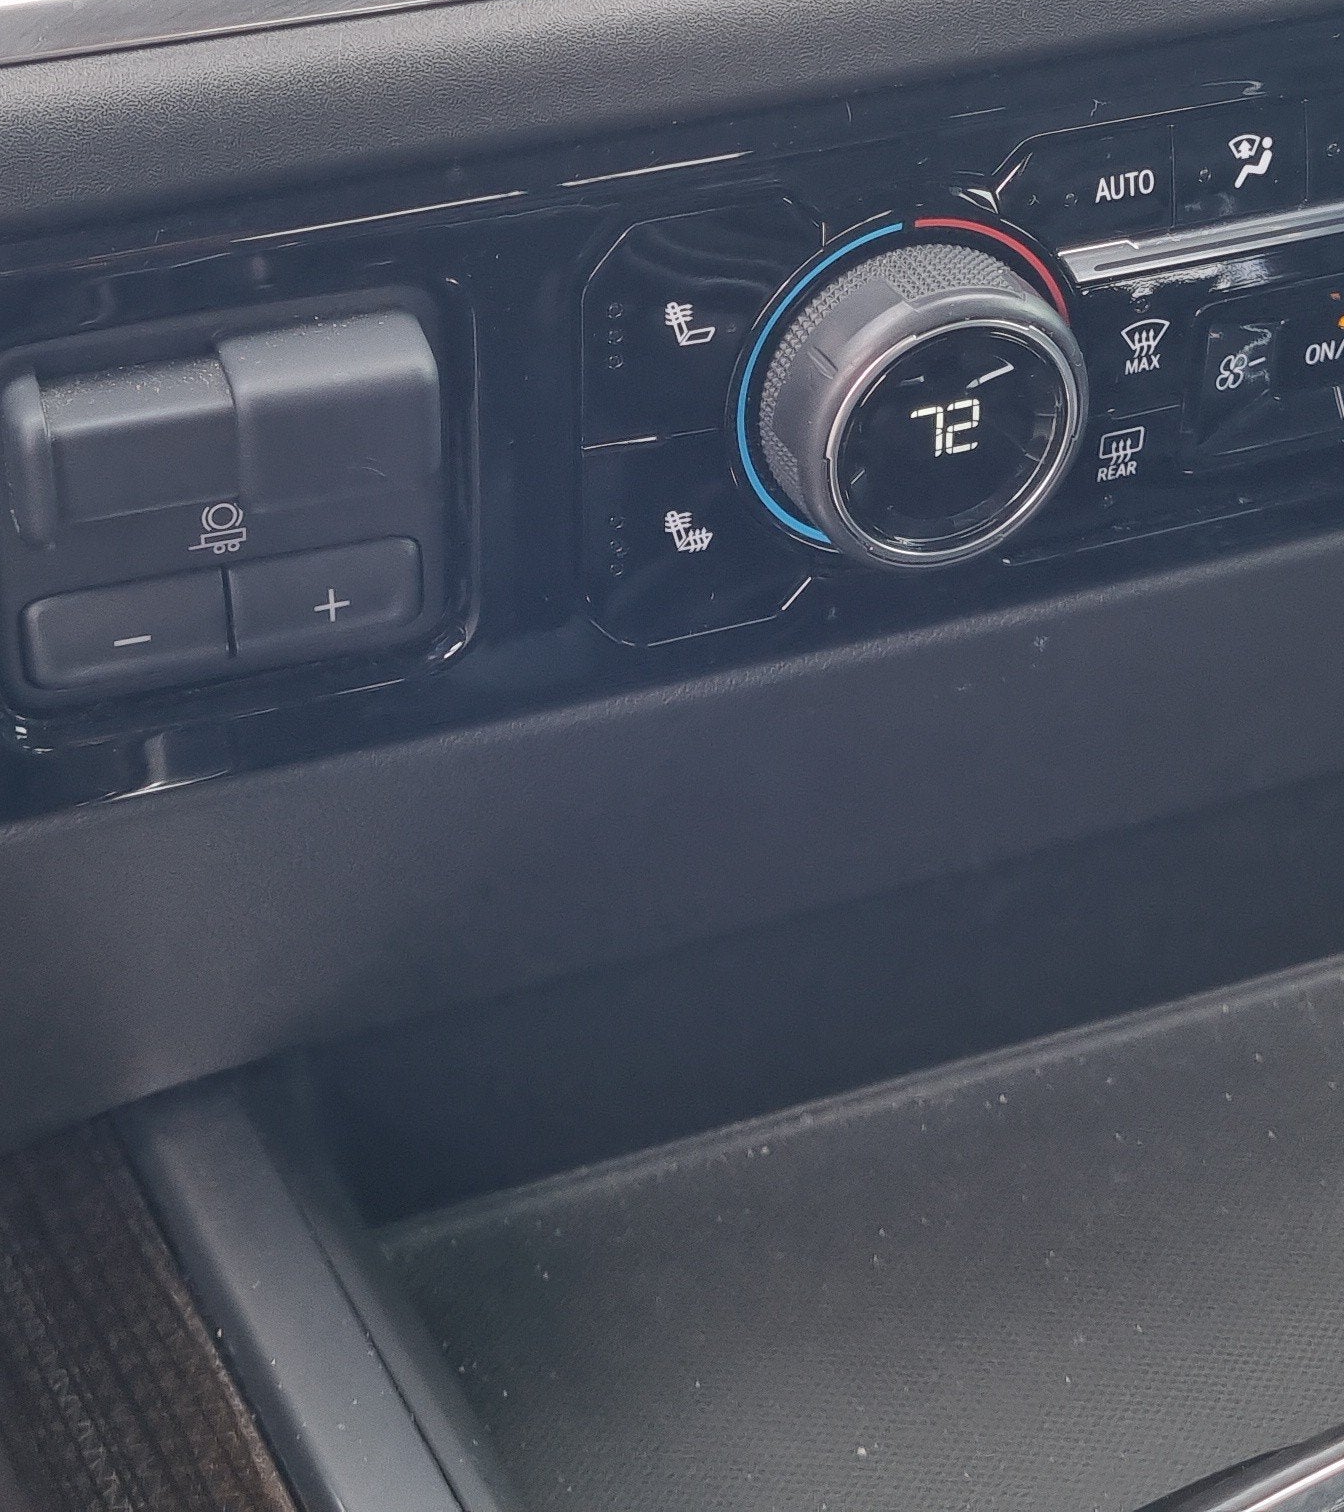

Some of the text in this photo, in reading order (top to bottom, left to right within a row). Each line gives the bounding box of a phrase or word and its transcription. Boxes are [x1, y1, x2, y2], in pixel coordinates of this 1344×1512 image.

[1095, 169, 1155, 204] AUTO
[1124, 354, 1161, 376] MAX
[910, 398, 981, 458] 72
[1096, 460, 1138, 483] REAR
